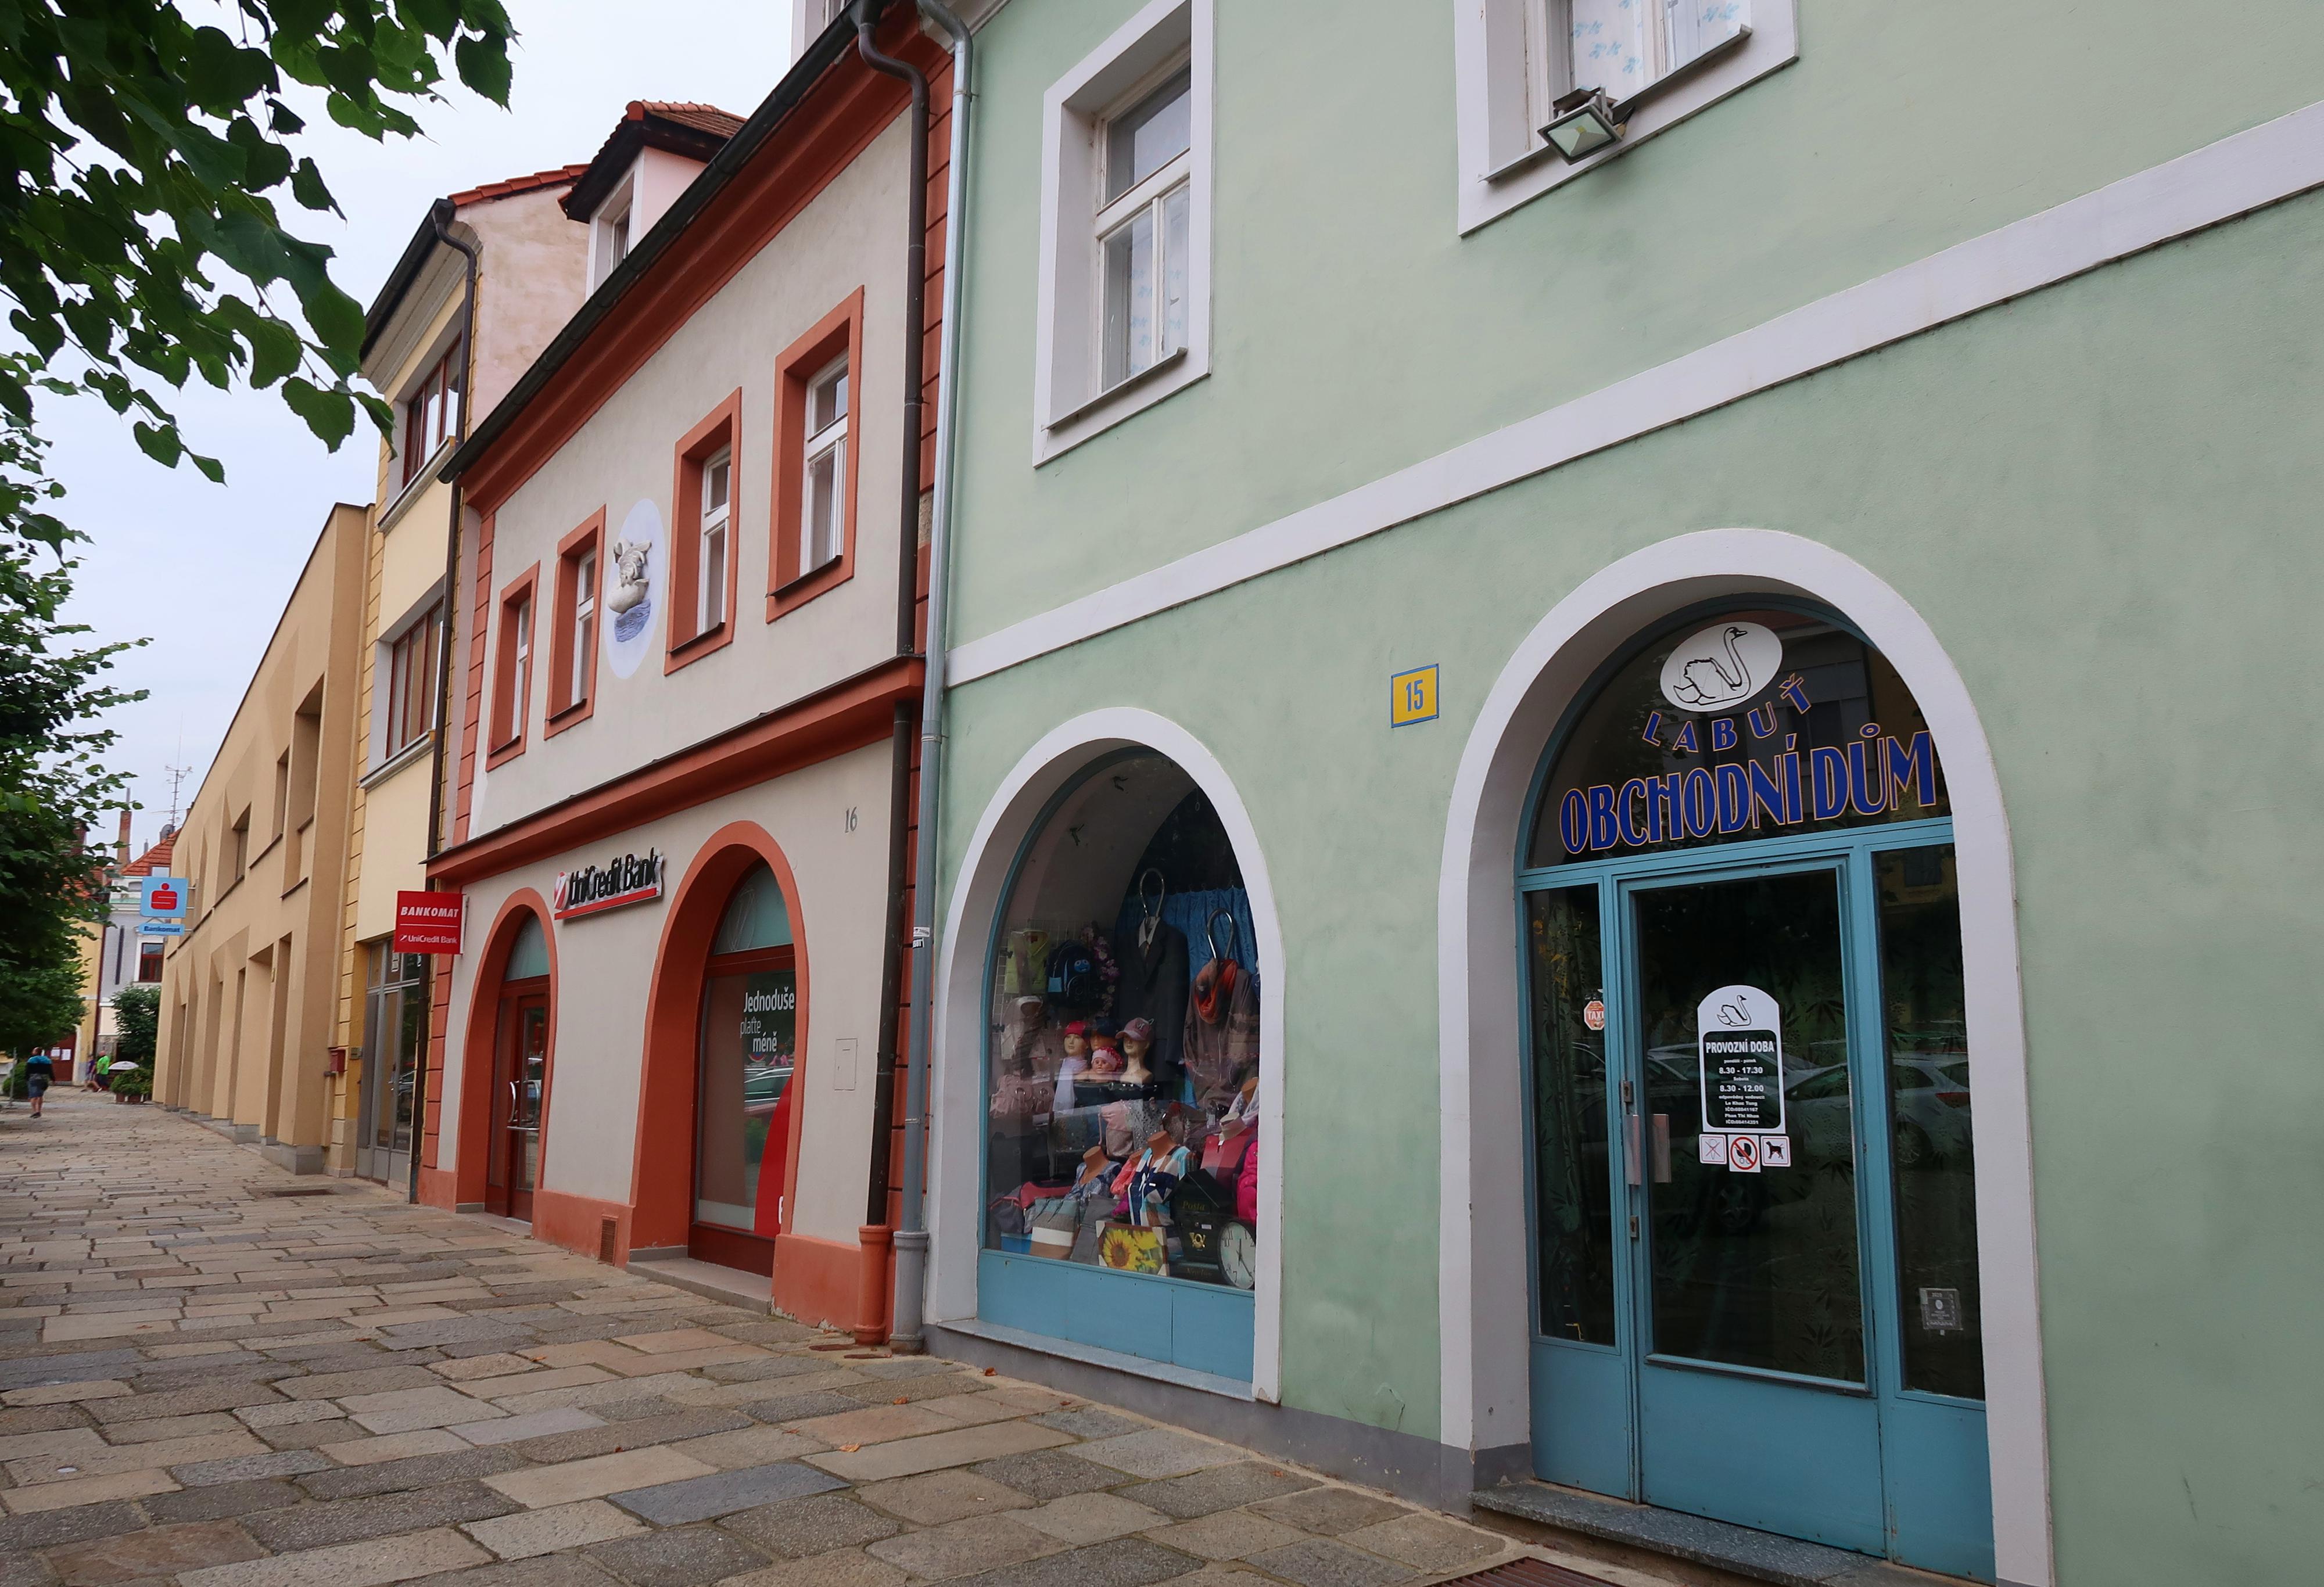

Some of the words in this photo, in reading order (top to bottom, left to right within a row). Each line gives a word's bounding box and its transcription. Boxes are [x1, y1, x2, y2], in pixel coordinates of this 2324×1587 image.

[1405, 679, 1423, 712] 15
[1642, 673, 1812, 753] LABUŤ
[1559, 733, 1803, 854] OBCHODNÍ
[1814, 723, 1936, 821] DŮM
[845, 806, 858, 833] 16
[569, 857, 622, 906] UniCredit
[623, 847, 658, 891] Bank
[400, 906, 459, 918] BANKOMAT
[408, 935, 440, 943] UniCredit
[440, 936, 458, 944] Bank
[744, 986, 795, 1013] Jednoduše
[752, 1031, 777, 1053] méně
[1706, 1039, 1748, 1053] PROVOZNÍ
[1750, 1040, 1775, 1053] DOBA
